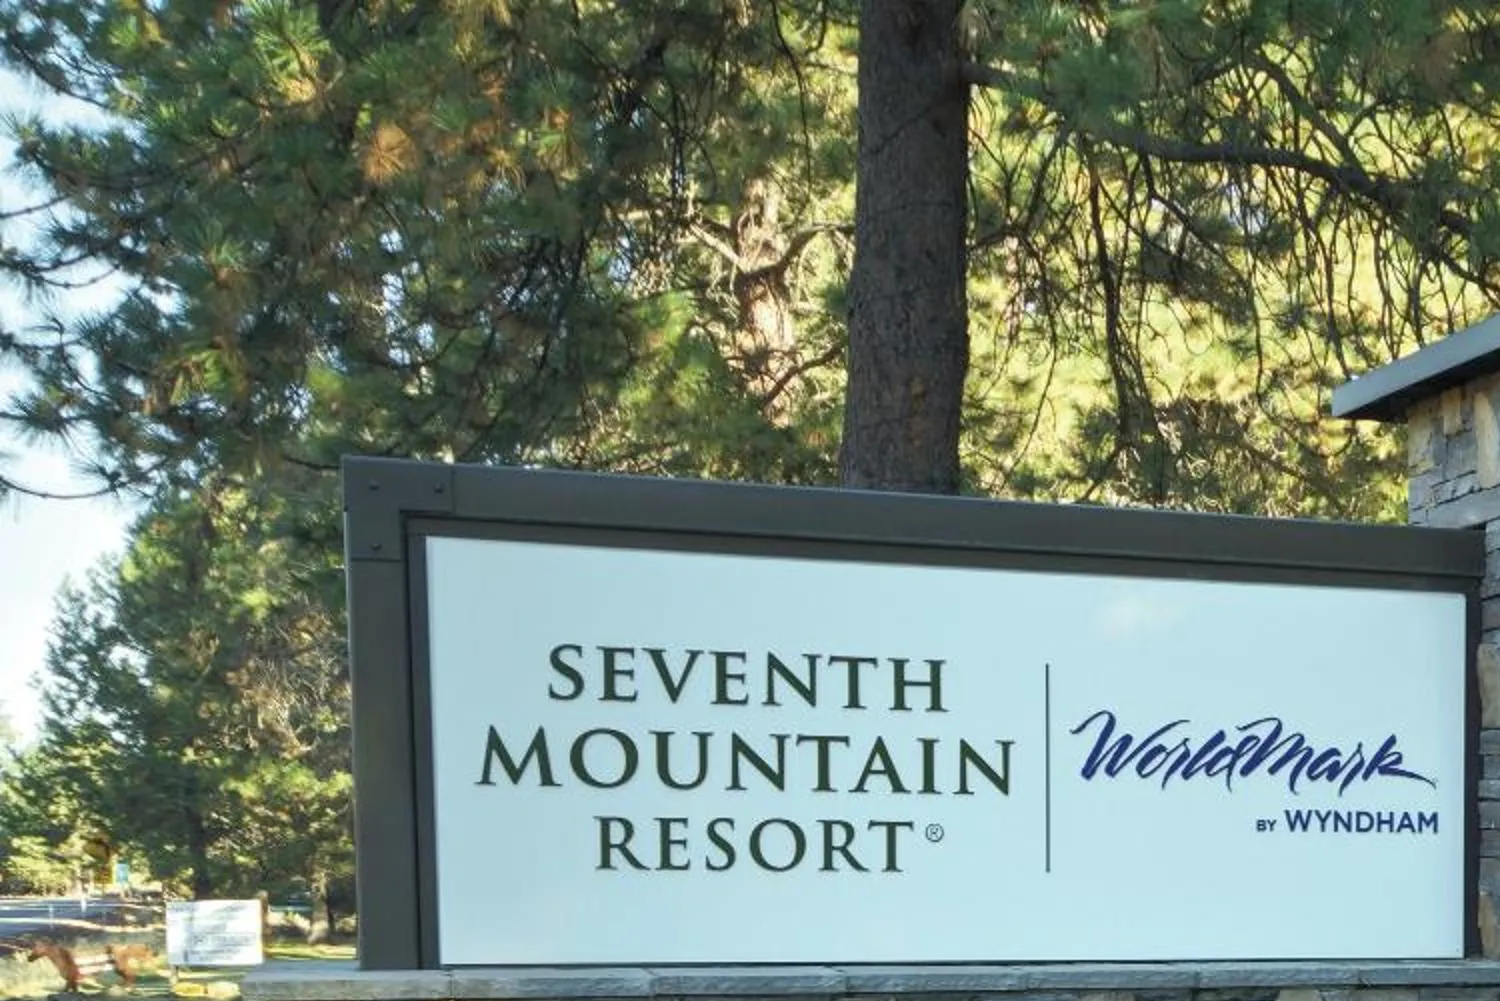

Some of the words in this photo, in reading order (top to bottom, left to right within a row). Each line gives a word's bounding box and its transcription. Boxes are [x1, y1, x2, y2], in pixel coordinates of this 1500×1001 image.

[548, 642, 949, 713] SEVENTH
[473, 723, 1016, 796] MOUNTAIN
[1069, 709, 1437, 796] WorldMark
[1255, 817, 1277, 833] BY
[1284, 809, 1439, 834] WYNDHAM
